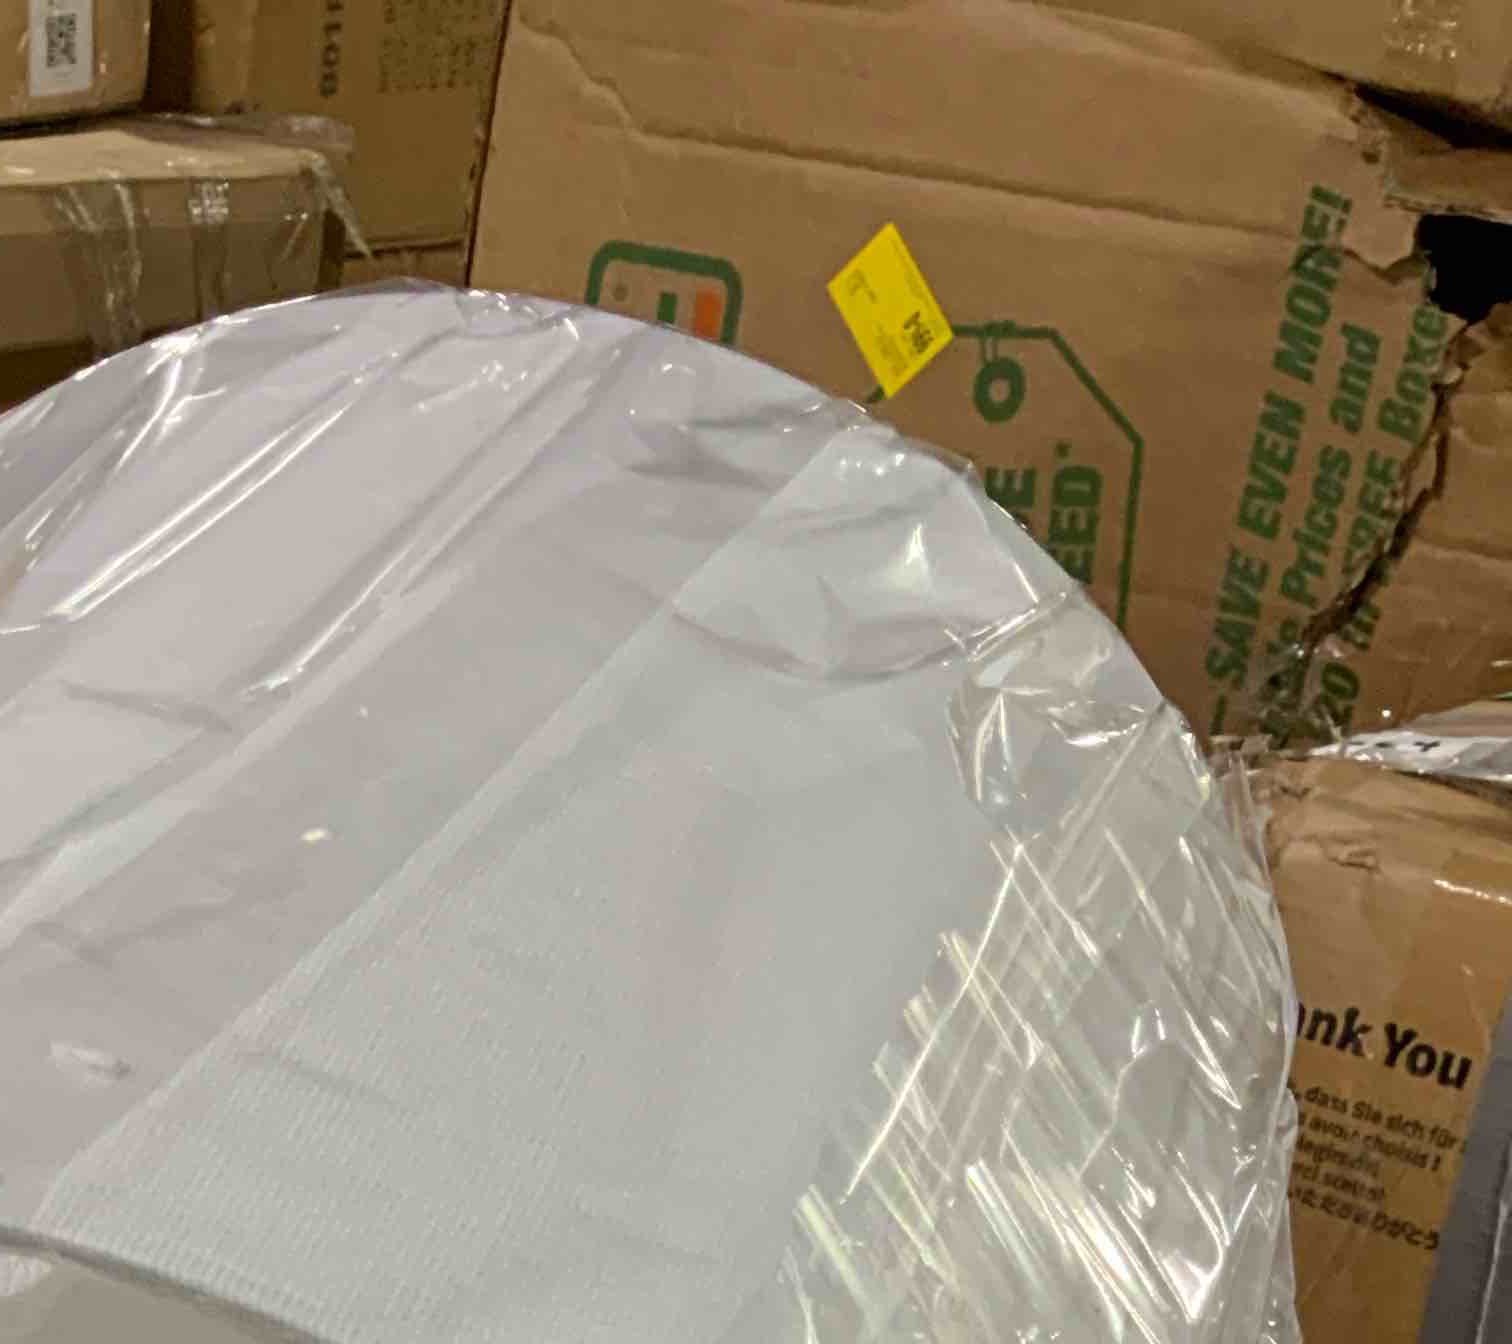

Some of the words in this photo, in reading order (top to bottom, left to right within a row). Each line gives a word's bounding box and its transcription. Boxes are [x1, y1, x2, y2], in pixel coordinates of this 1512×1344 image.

[1271, 184, 1352, 385] MORE!
[1237, 388, 1305, 540] EVEN
[1280, 444, 1354, 608] Prices
[1328, 320, 1382, 434] and
[1205, 545, 1271, 690] SAVE
[1384, 1022, 1472, 1089] You
